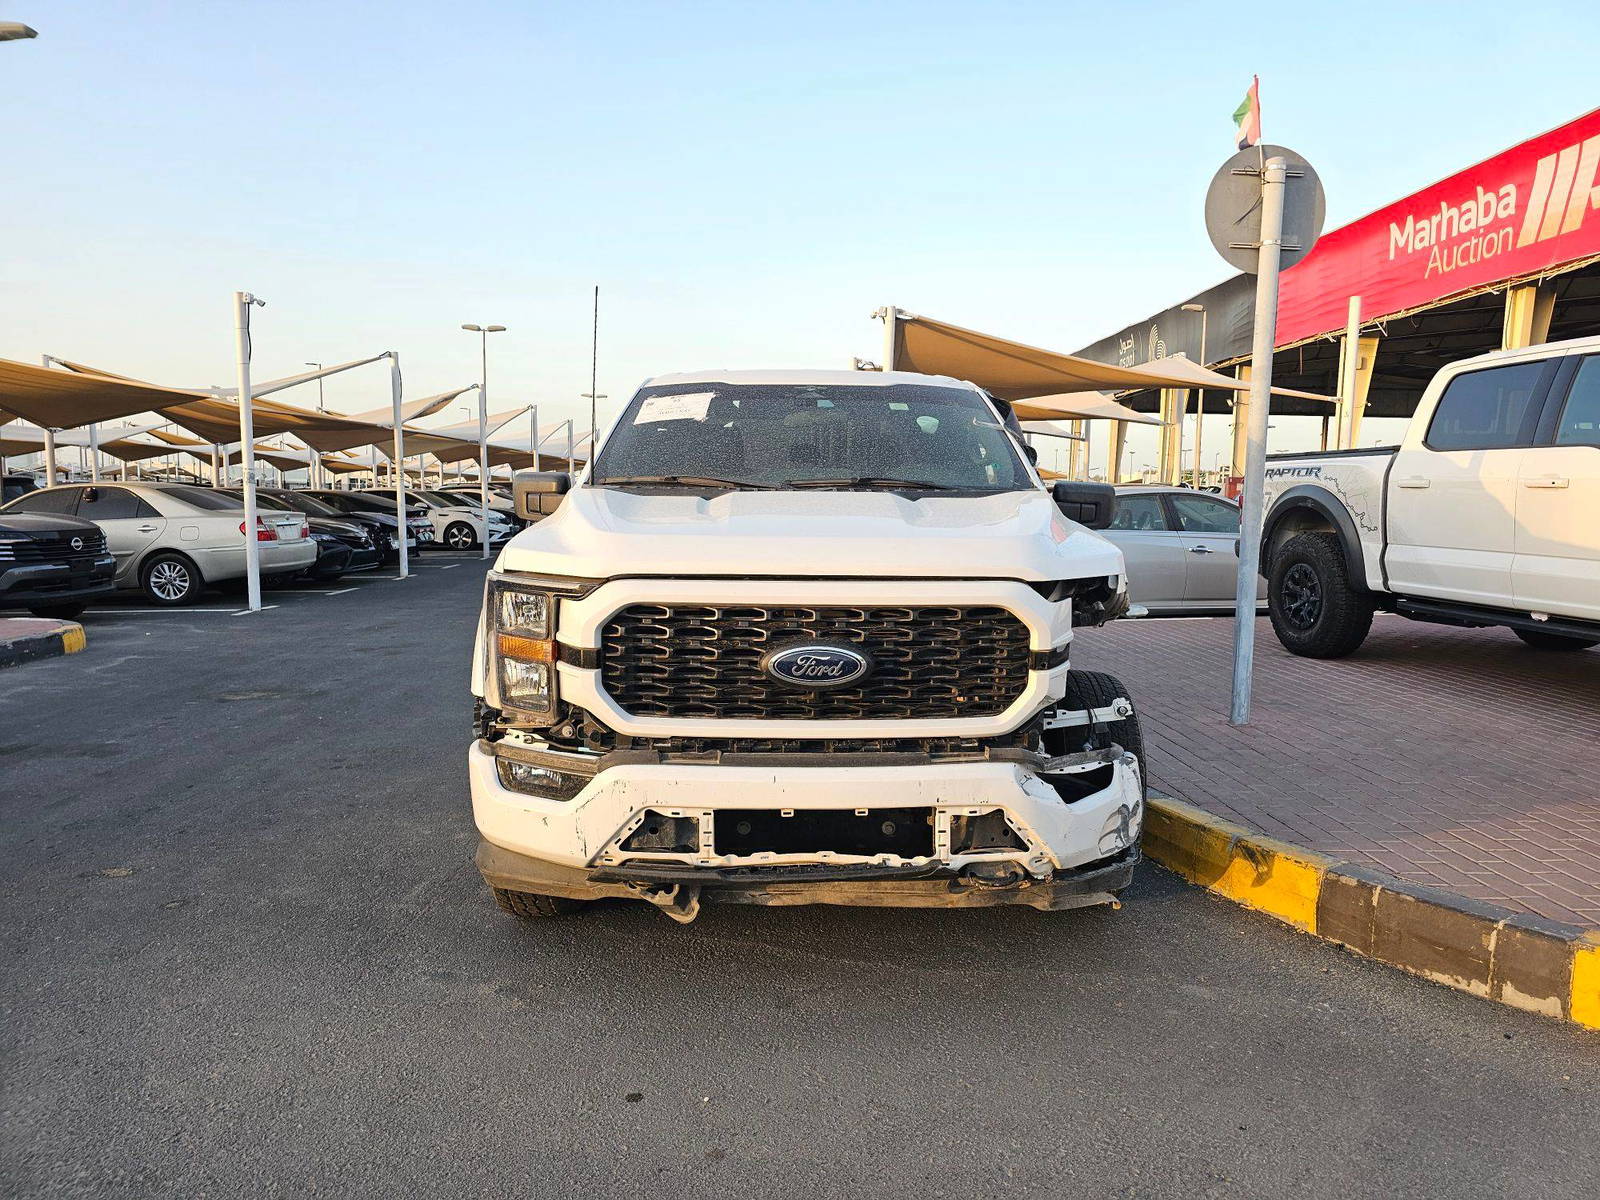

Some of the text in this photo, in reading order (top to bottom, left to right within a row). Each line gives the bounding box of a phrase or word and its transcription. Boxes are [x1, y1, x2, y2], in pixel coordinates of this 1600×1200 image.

[1389, 183, 1517, 261] Marhaba
[1424, 225, 1515, 280] Auction
[1264, 466, 1322, 481] RAPTOR
[791, 654, 844, 677] Ford
